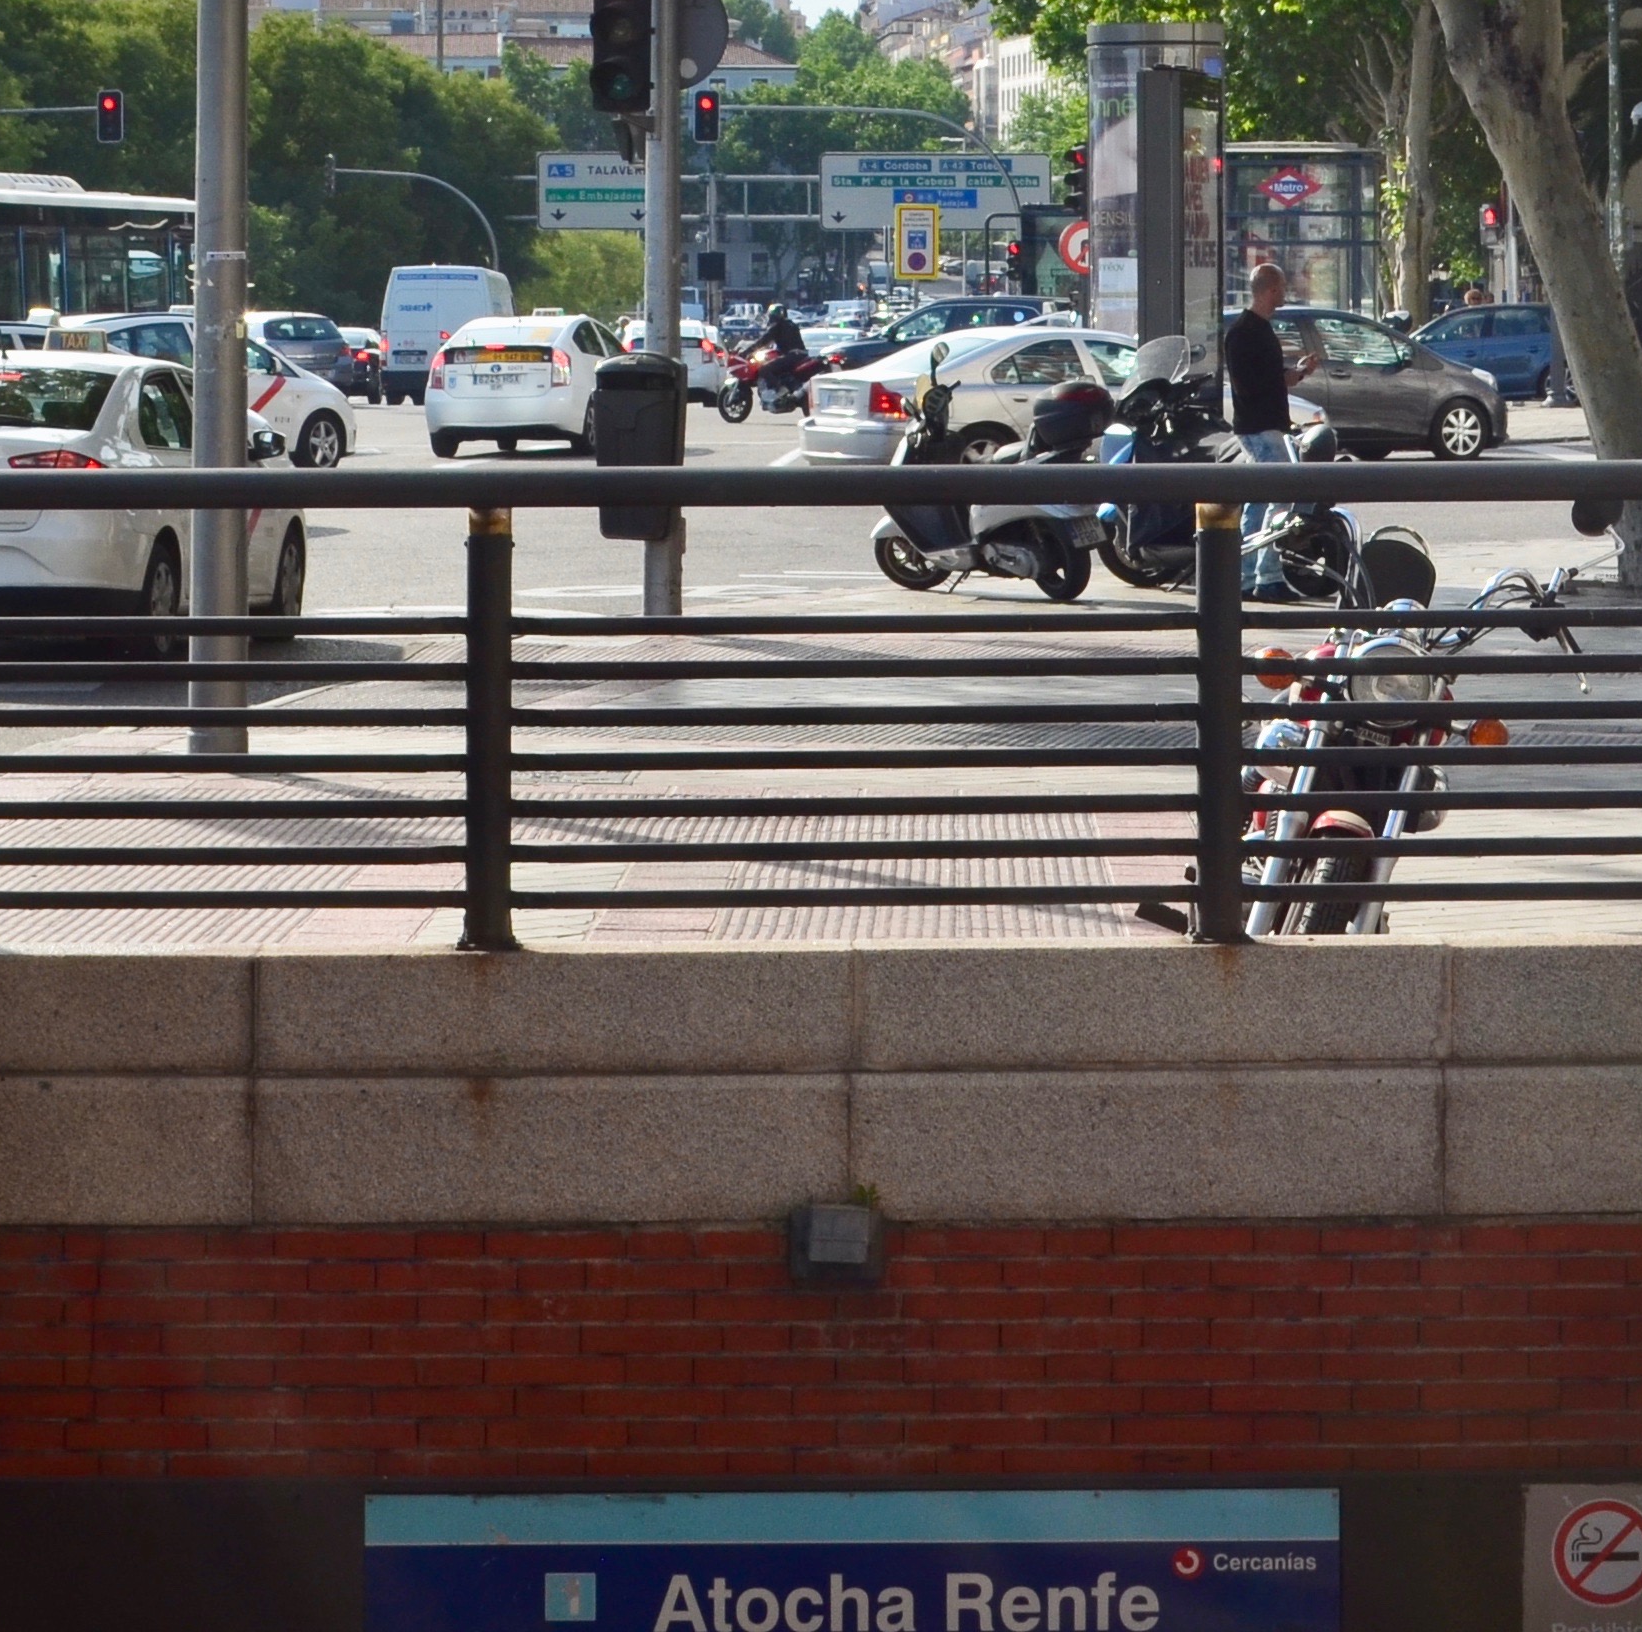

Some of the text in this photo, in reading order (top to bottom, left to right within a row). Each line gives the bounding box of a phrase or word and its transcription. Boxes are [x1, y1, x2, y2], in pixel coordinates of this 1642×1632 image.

[549, 165, 645, 176] A-5 TALAVER
[880, 176, 894, 186] de
[916, 176, 955, 186] Cabeza
[967, 176, 1038, 186] calle Aocha
[1273, 182, 1304, 193] Metro
[579, 190, 645, 202] Embajadore
[61, 333, 89, 349] TAXI
[1213, 1551, 1317, 1572] Cercanías
[655, 1571, 1160, 1632] Atocha Renfe
